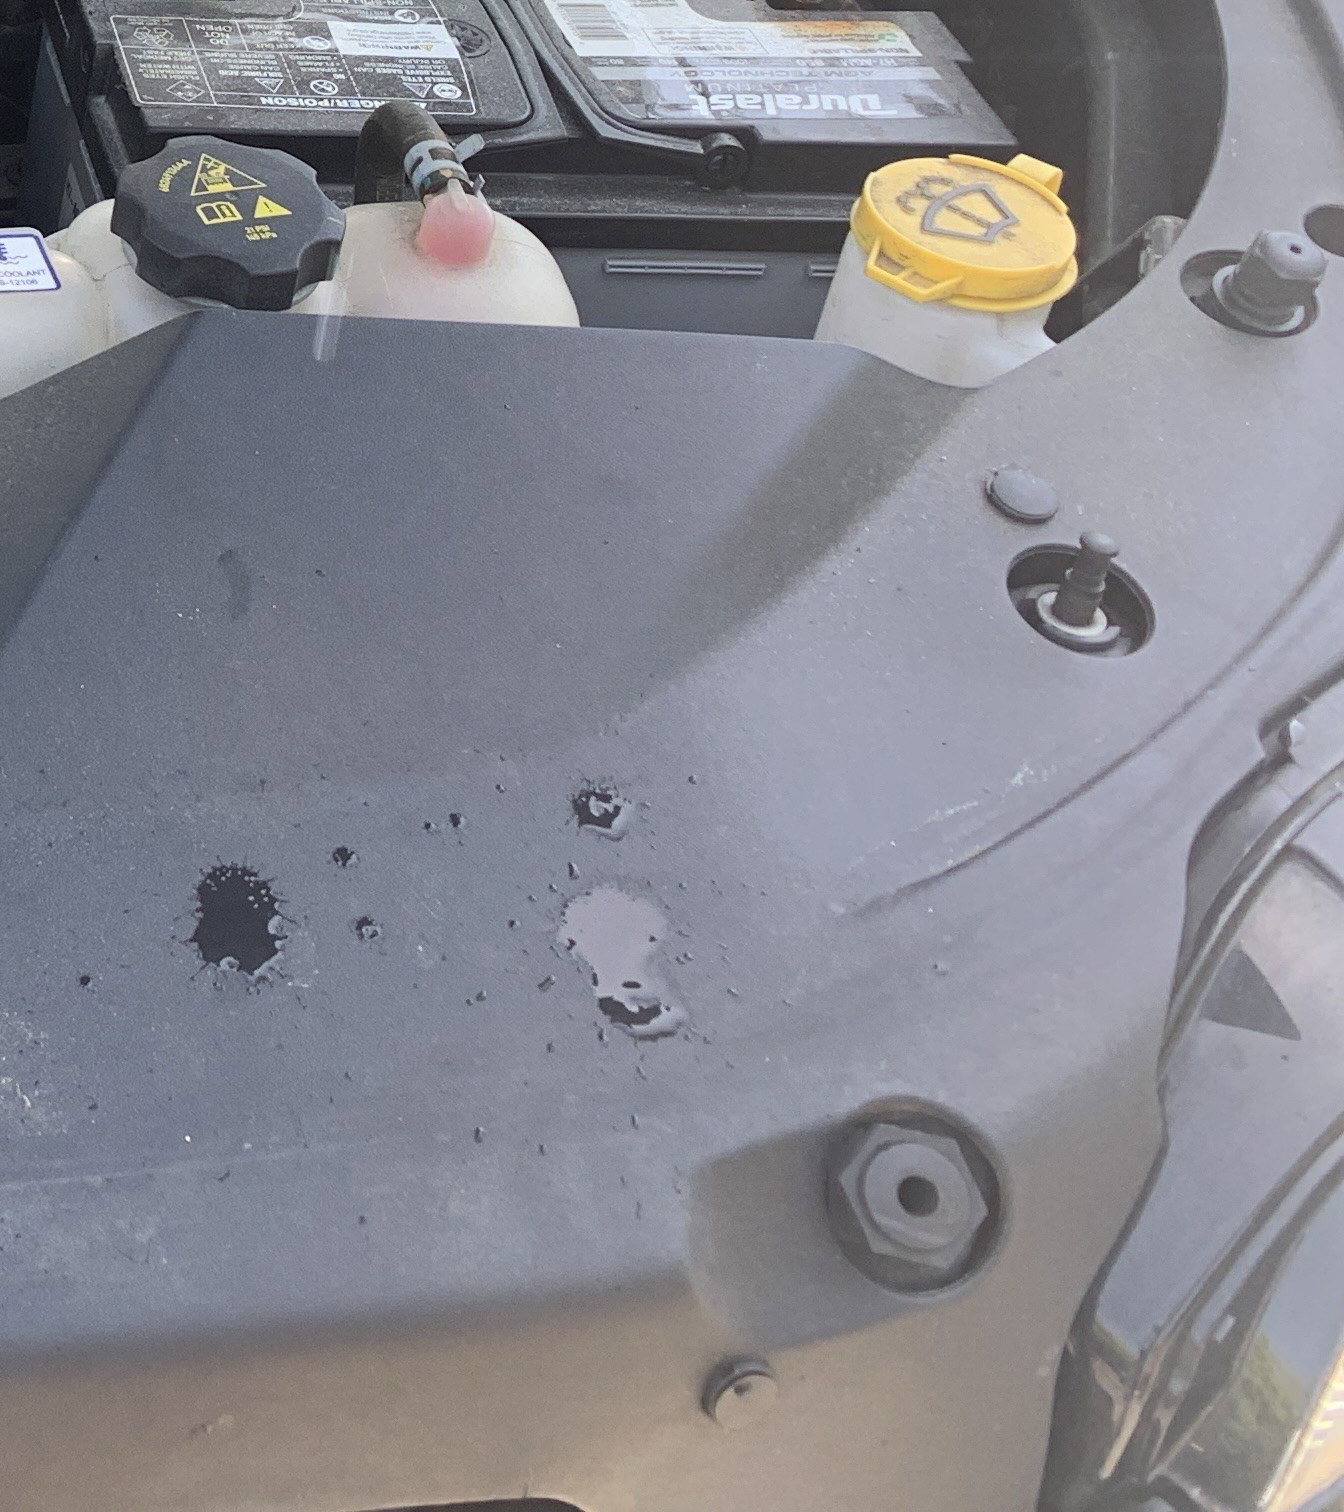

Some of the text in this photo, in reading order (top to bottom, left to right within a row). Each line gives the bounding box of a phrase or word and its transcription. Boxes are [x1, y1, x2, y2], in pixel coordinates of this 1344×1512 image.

[670, 69, 874, 78] AGM TECHNOLOGY
[685, 83, 819, 94] PLATINUM
[688, 93, 898, 117] Duralast
